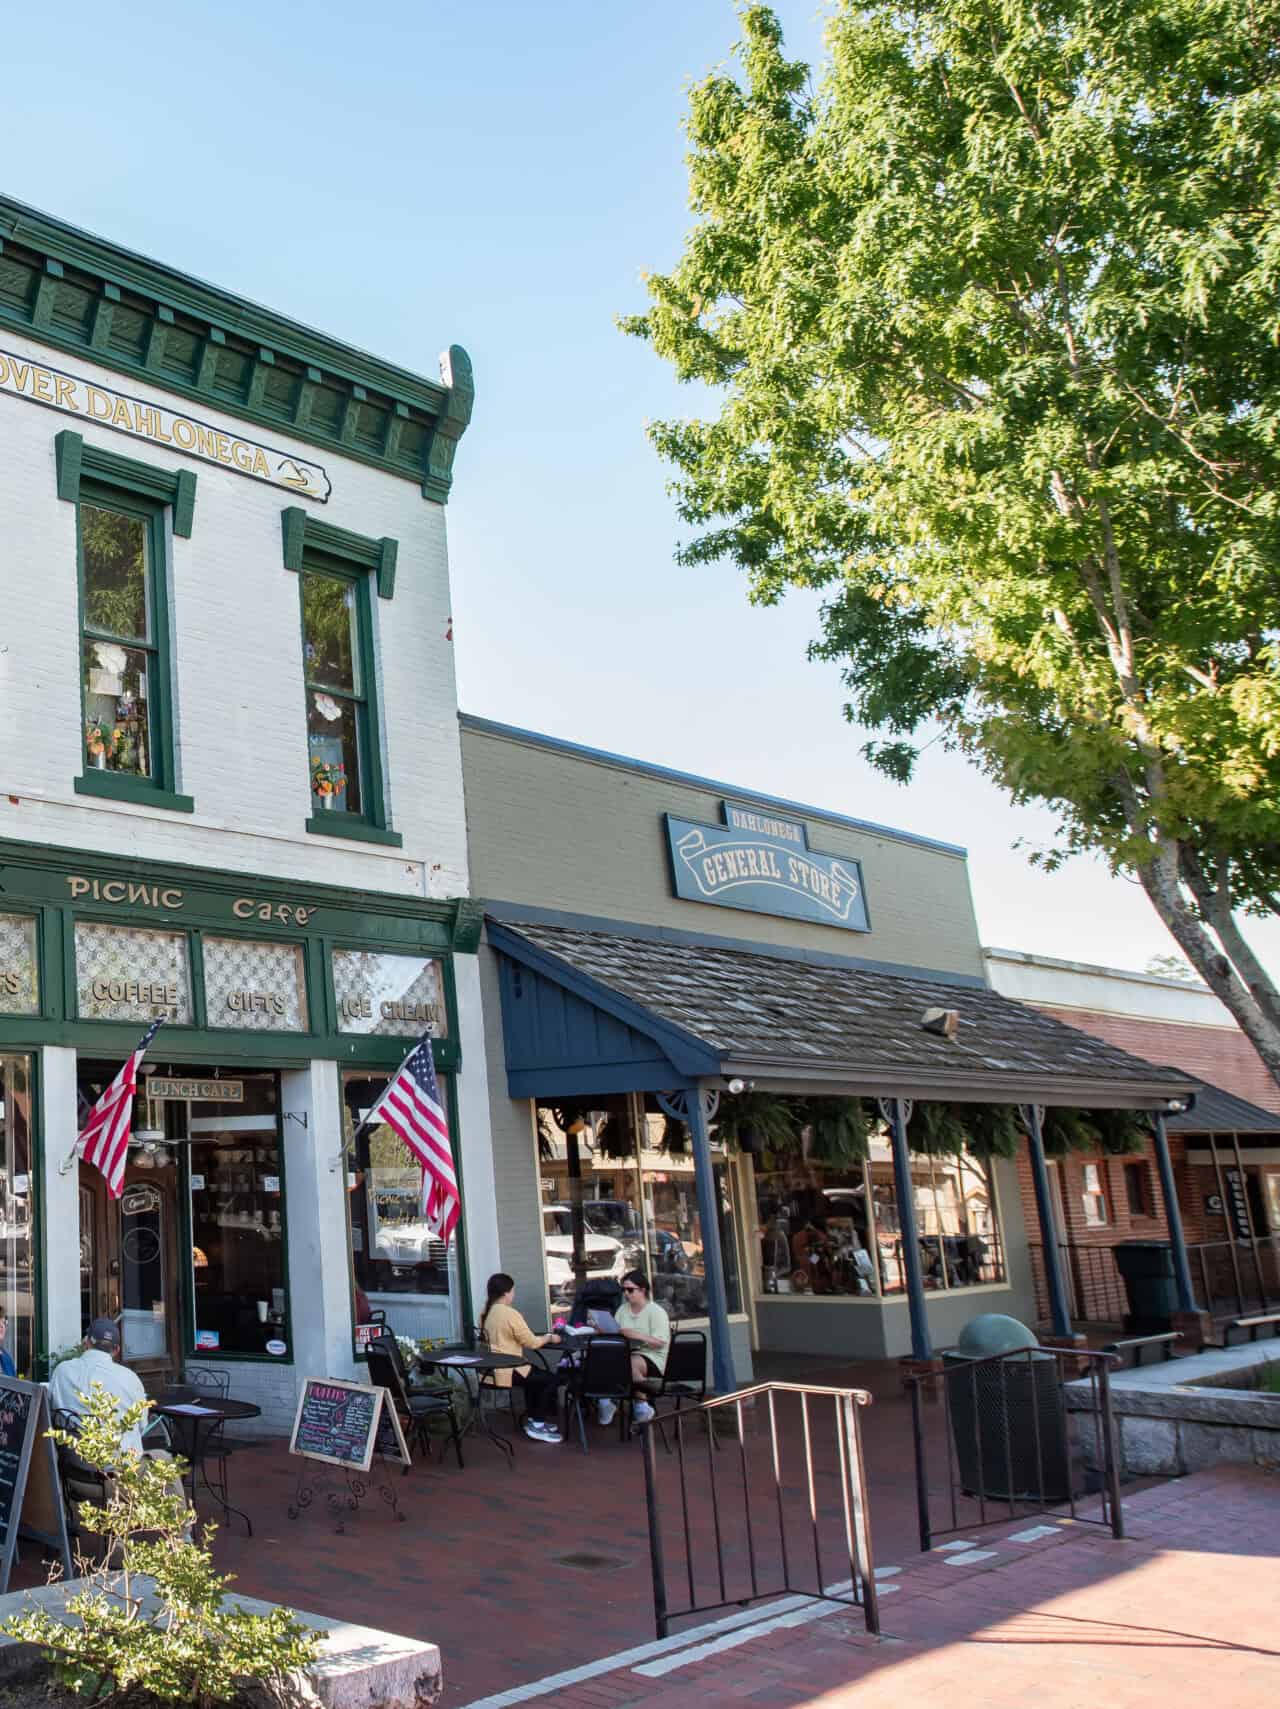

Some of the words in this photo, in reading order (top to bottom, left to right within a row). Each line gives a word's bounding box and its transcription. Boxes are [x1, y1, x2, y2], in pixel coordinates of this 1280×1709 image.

[86, 385, 271, 479] DAHLONEGA
[67, 876, 185, 909] PICNIC
[702, 848, 781, 886] GENERAL
[788, 857, 842, 909] STORE
[92, 980, 177, 1006] COFFEE
[226, 990, 287, 1016] GIFTS
[341, 992, 373, 1018] ICE
[380, 1000, 441, 1023] CREAM
[151, 1080, 200, 1097] LUNCH
